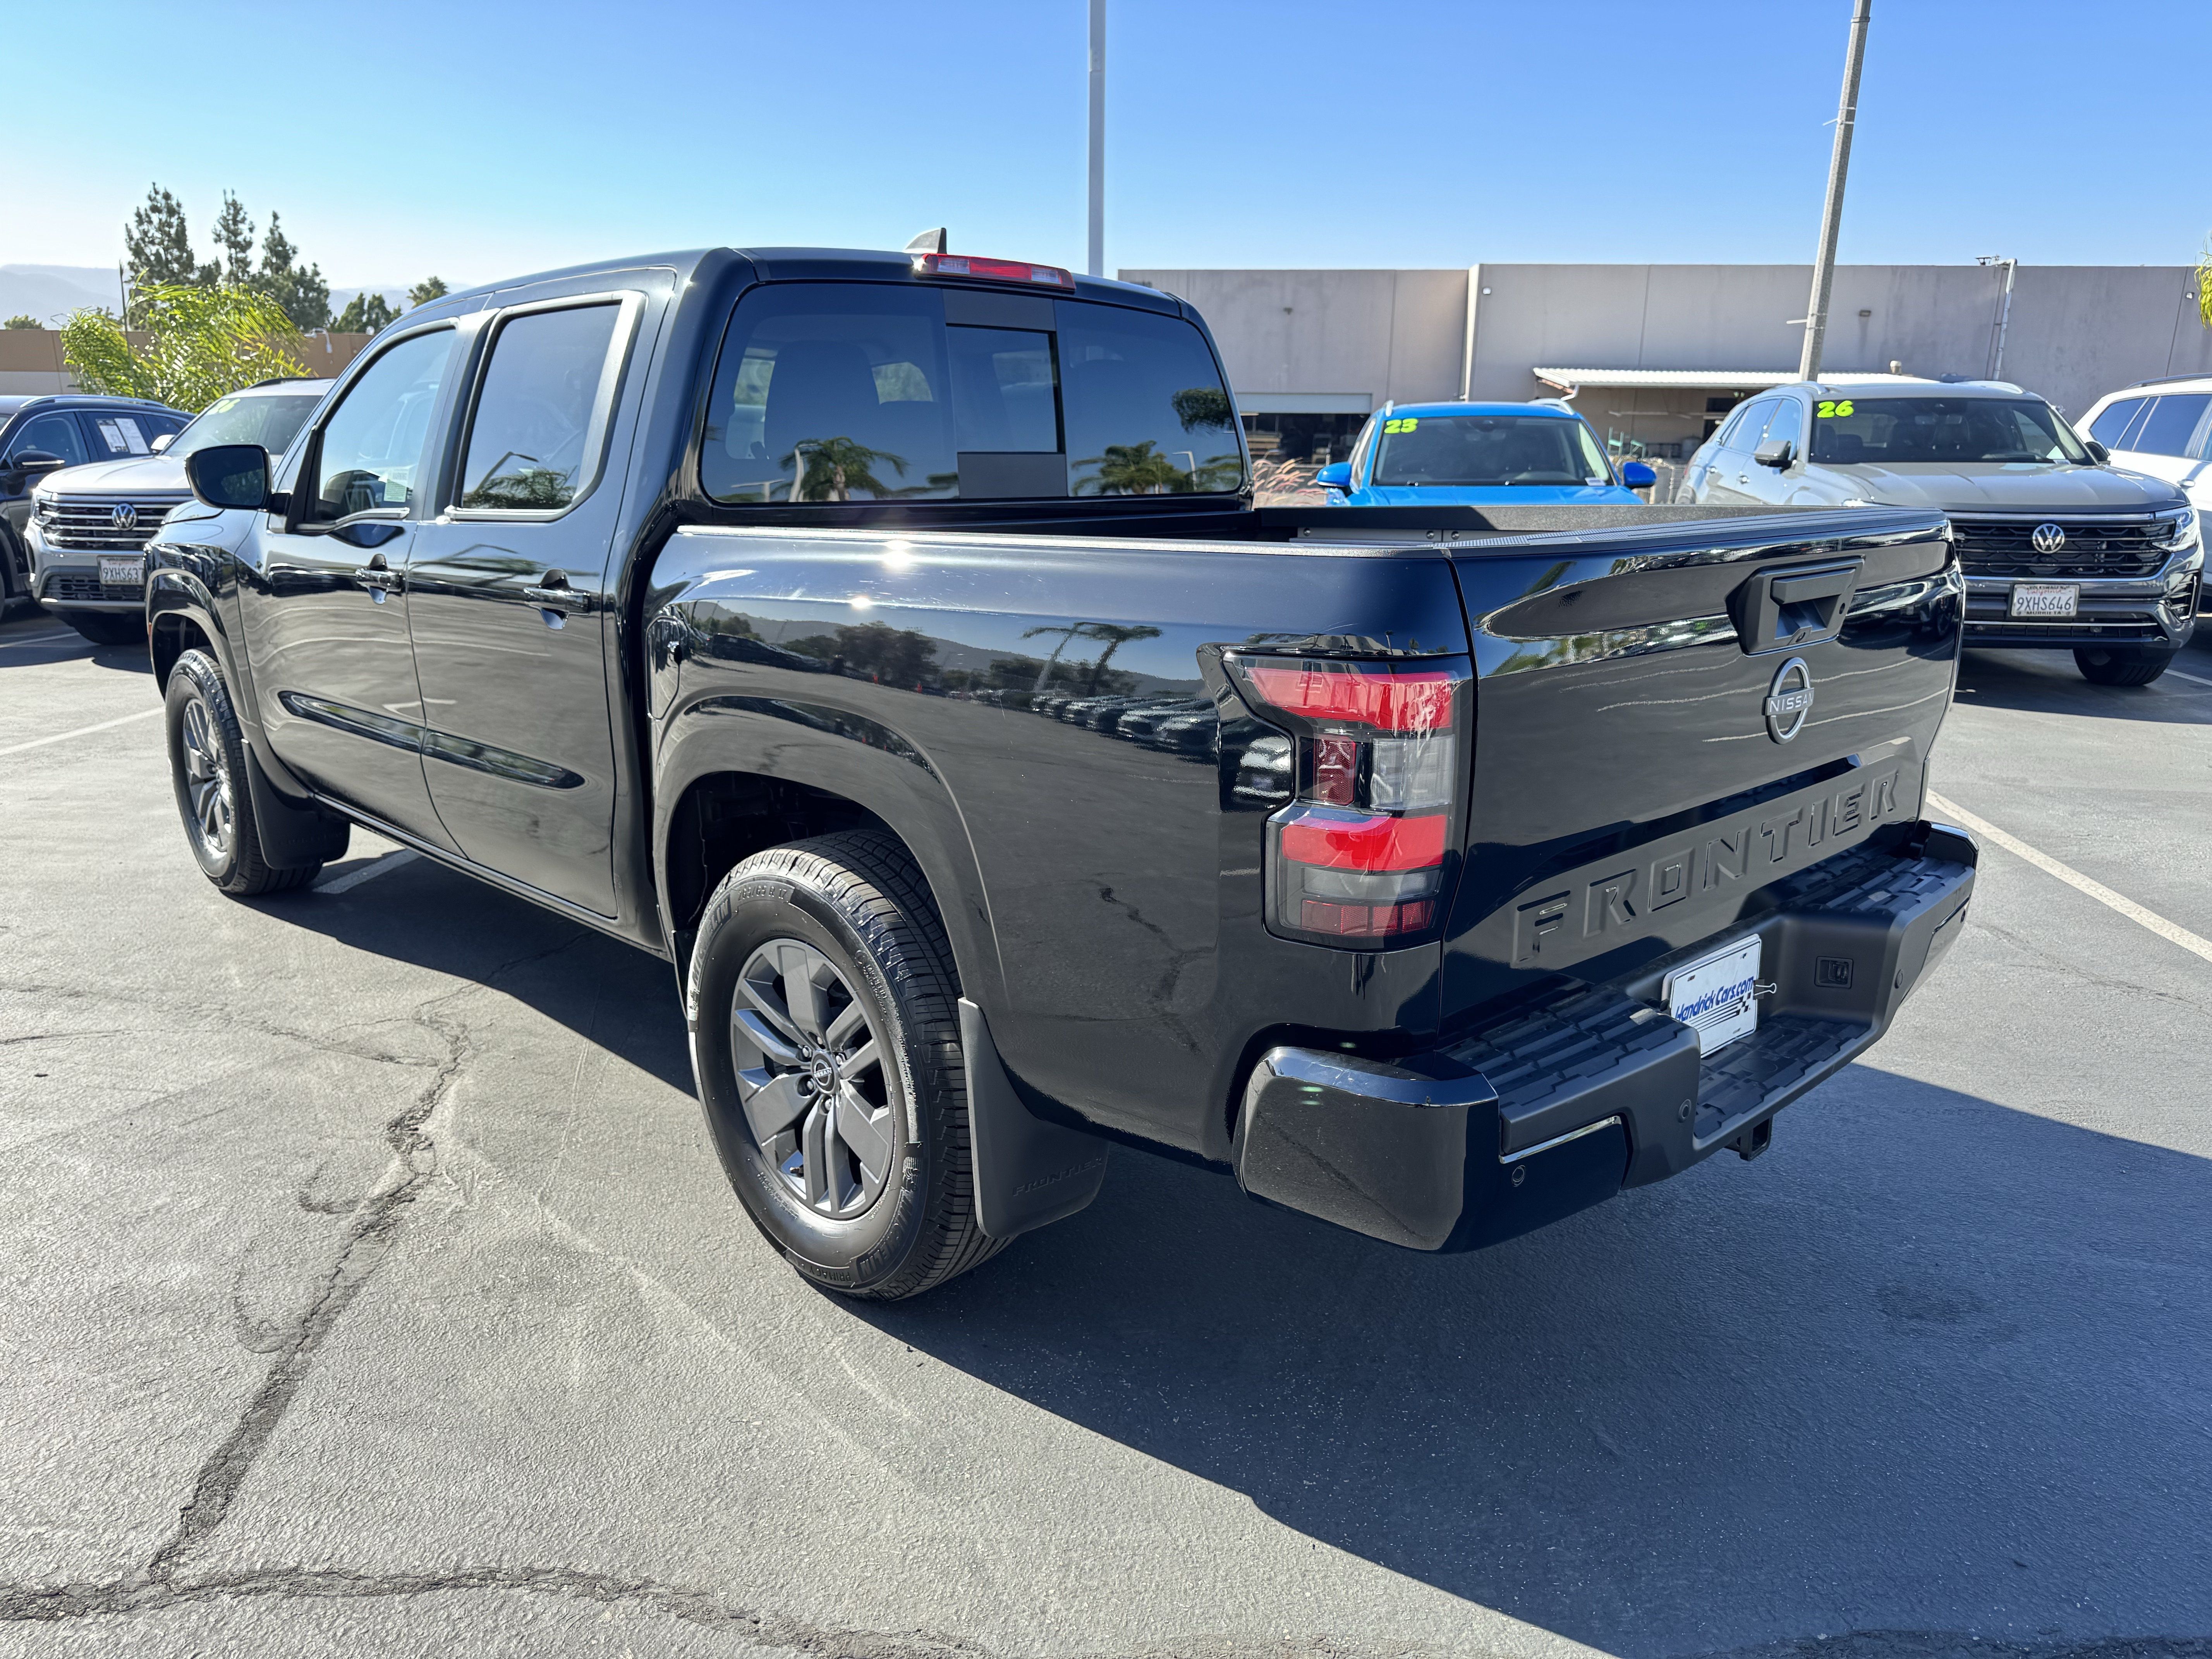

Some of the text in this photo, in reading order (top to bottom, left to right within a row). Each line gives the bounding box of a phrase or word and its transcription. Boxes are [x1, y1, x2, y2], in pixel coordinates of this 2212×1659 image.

[1817, 400, 1854, 418] 26
[1384, 418, 1418, 434] 23
[2017, 597, 2072, 611] 9XHS646
[1770, 692, 1812, 713] NISSAN
[1512, 771, 1898, 968] FRONTIER
[1675, 990, 1716, 1022] Hendrick
